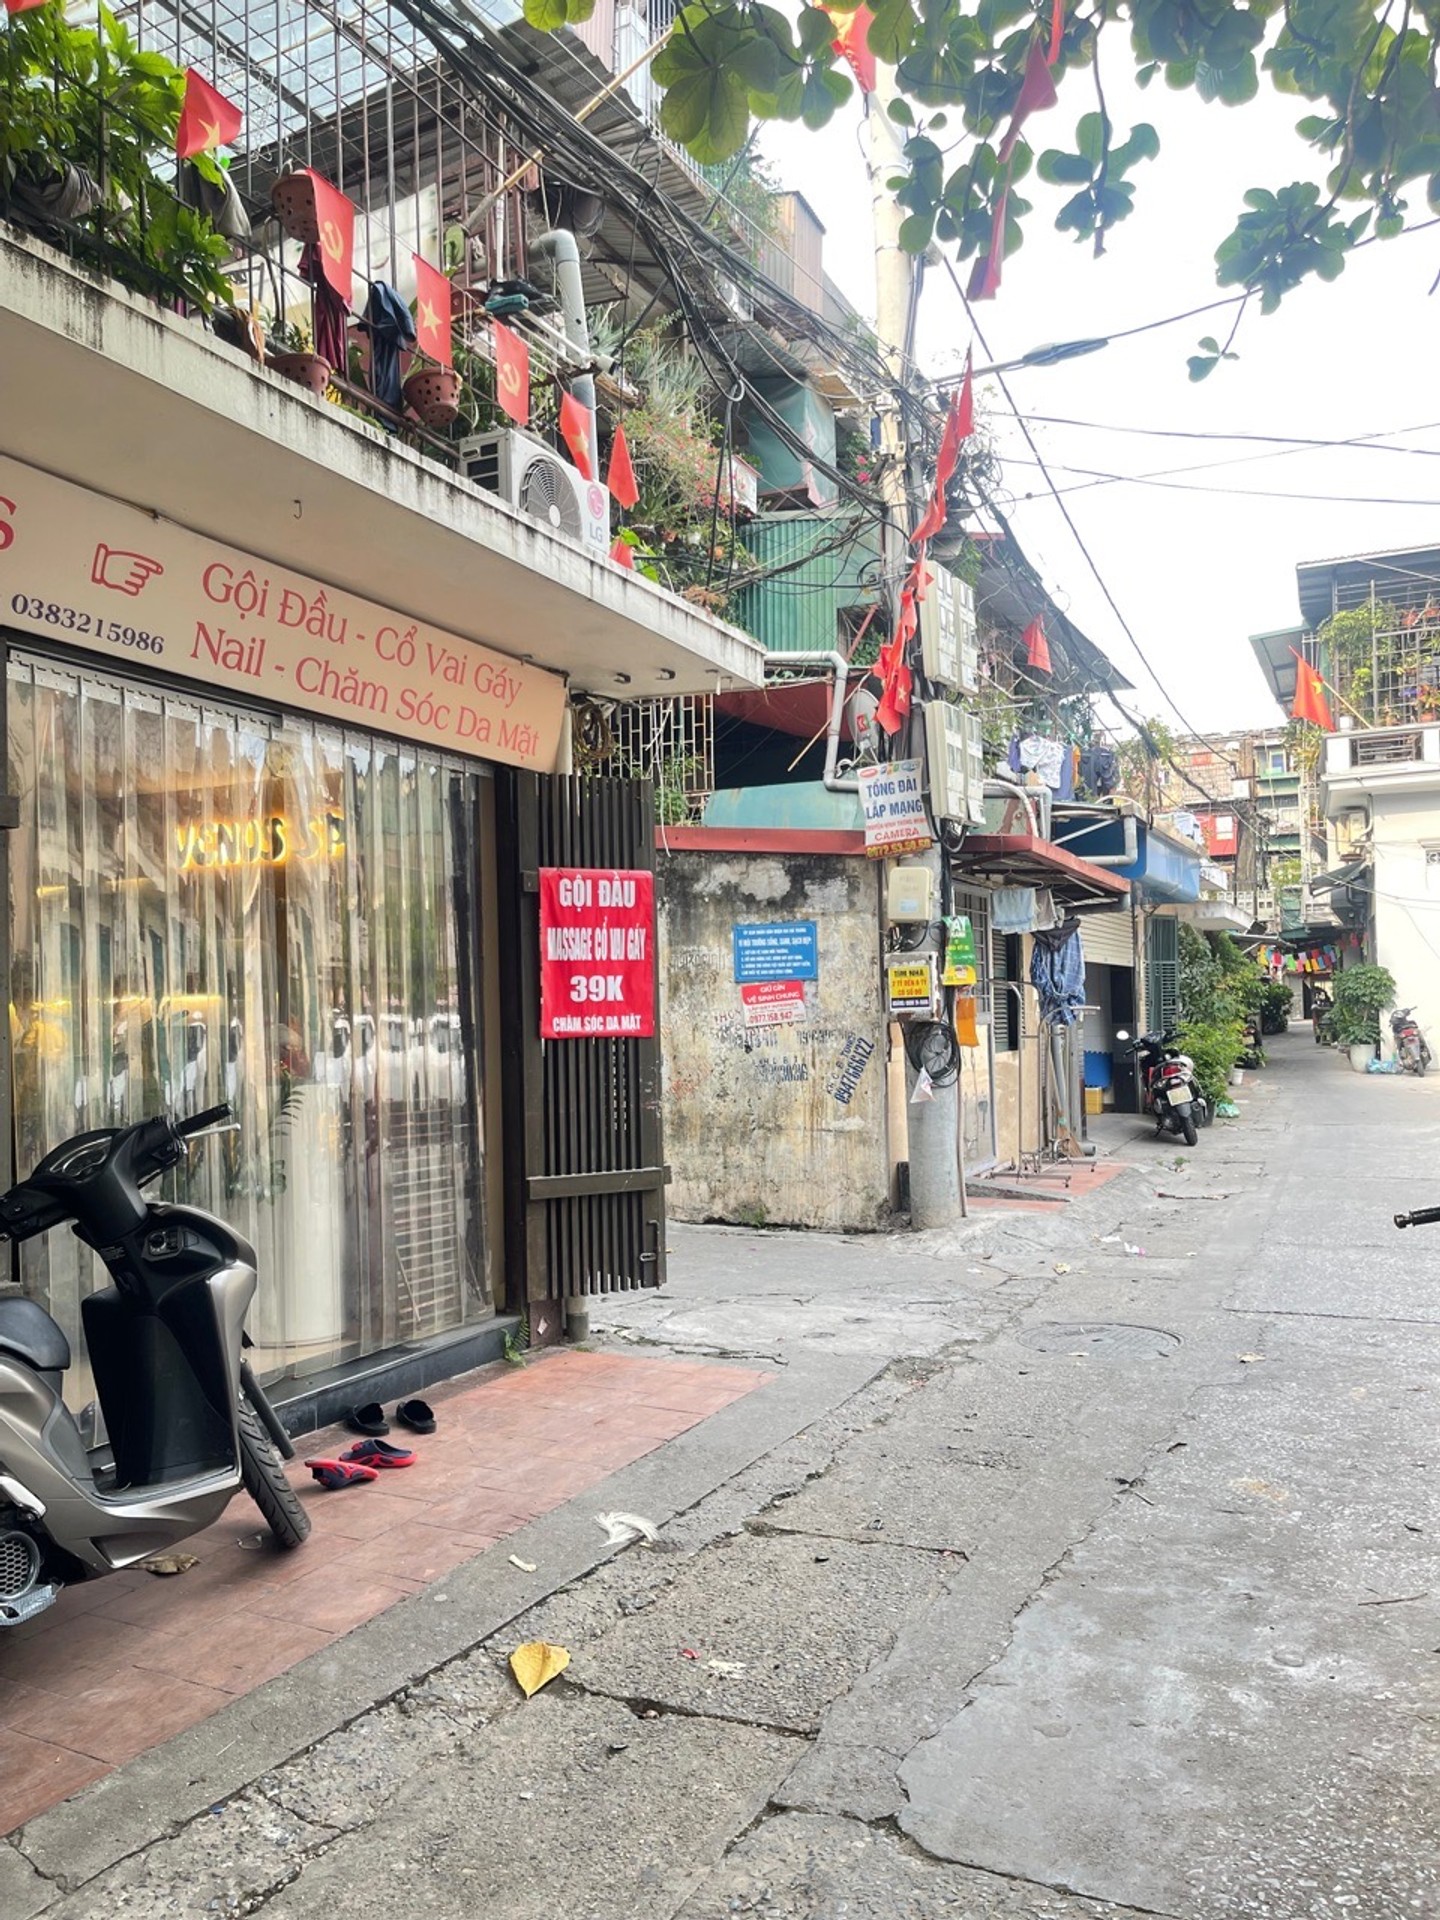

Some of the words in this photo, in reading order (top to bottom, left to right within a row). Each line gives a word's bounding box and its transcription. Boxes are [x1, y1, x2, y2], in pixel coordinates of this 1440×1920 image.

[589, 522, 603, 544] LG
[11, 593, 165, 655] 0383215986
[202, 562, 270, 620] Gội
[277, 589, 348, 645] Đầu
[375, 625, 418, 667] Cổ
[426, 642, 468, 686] Vai
[474, 663, 523, 709] Gáy
[190, 620, 266, 678] Nail
[295, 656, 389, 714] Chăm
[395, 688, 451, 731] Sóc
[455, 705, 492, 744] Da
[497, 719, 540, 761] Mặt
[898, 775, 918, 792] ĐÀI
[866, 800, 887, 820] LẮP
[889, 799, 923, 818] MẠNG
[874, 827, 920, 841] CAMERA
[559, 873, 593, 912] GỘI
[597, 870, 636, 908] ĐẦU
[546, 926, 592, 961] MASSAGE
[594, 915, 608, 961] CỔ
[609, 927, 625, 961] VAI
[627, 922, 646, 961] GÁY
[570, 974, 624, 1002] 39K
[775, 991, 801, 1000] CHUNG
[552, 1015, 582, 1033] CHĂM
[584, 1013, 604, 1032] SÓC
[605, 1015, 619, 1031] DA
[834, 1036, 876, 1105] 0947666122
